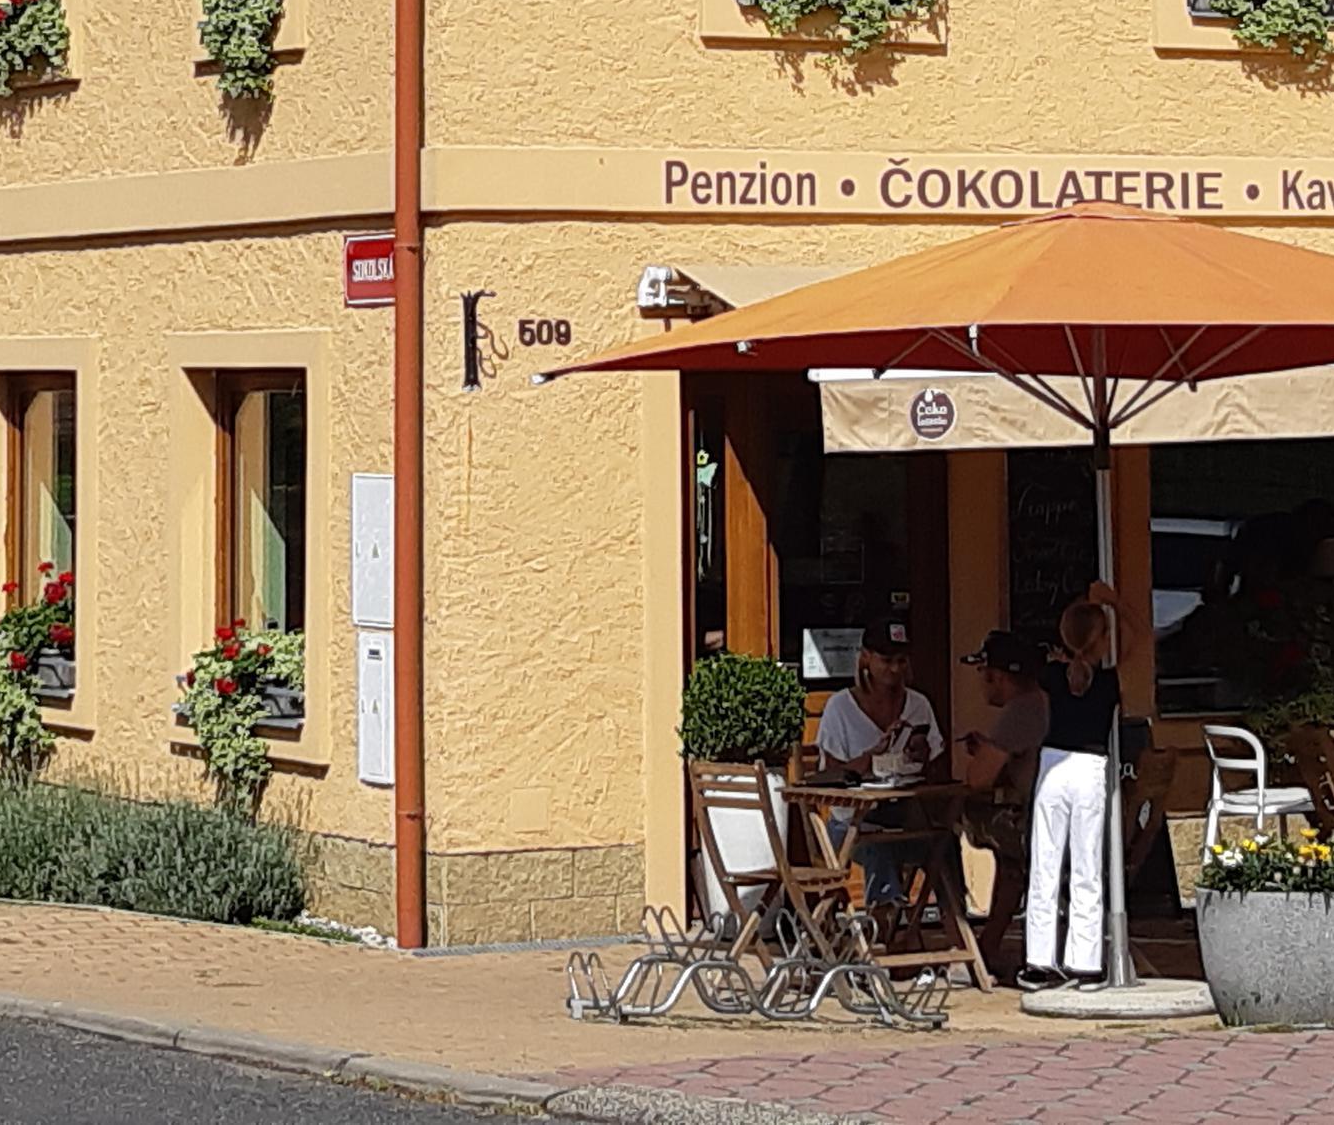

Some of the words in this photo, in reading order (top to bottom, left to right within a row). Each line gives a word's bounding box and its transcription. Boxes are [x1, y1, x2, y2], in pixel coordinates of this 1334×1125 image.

[665, 160, 817, 206] Penzion
[880, 157, 1223, 210] ČOKOLATERIE
[518, 319, 572, 346] 509
